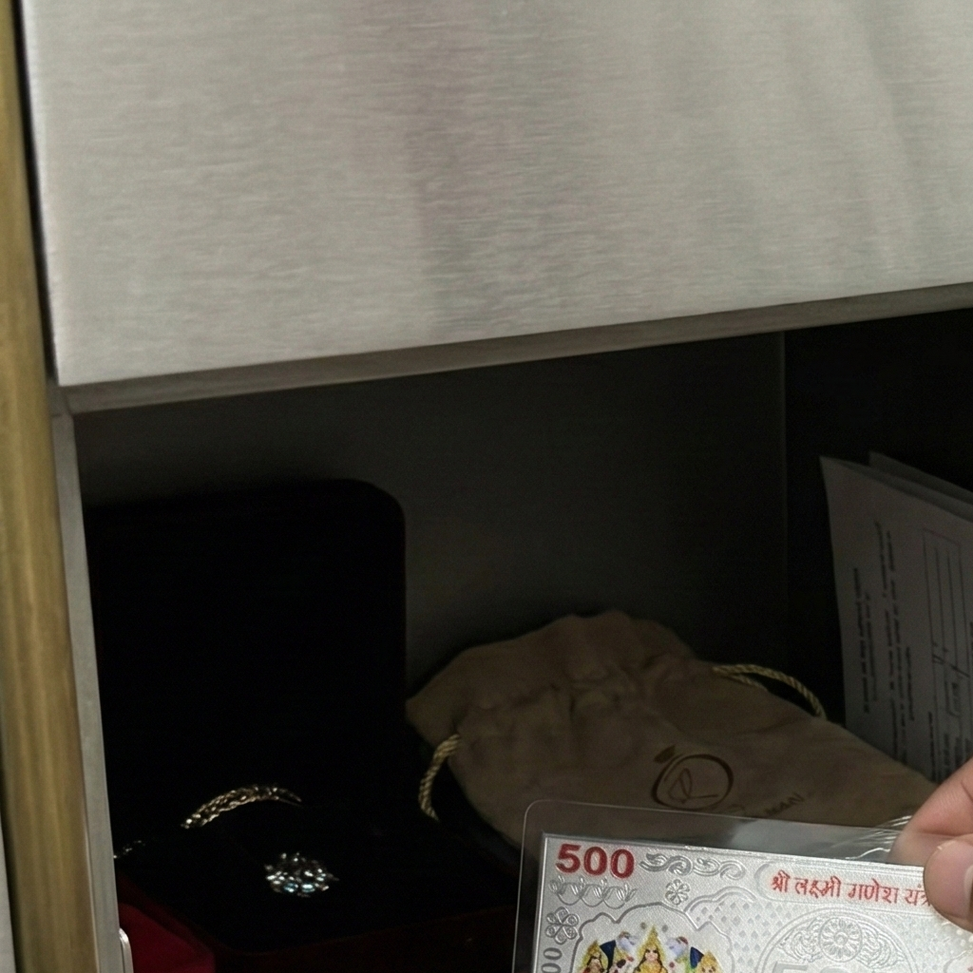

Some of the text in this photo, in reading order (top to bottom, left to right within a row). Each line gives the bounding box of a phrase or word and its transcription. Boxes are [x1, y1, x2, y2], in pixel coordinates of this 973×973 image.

[555, 843, 635, 879] 500
[771, 869, 791, 893] श्री
[794, 875, 842, 899] लक्ष्मी
[847, 878, 899, 904] गणेश
